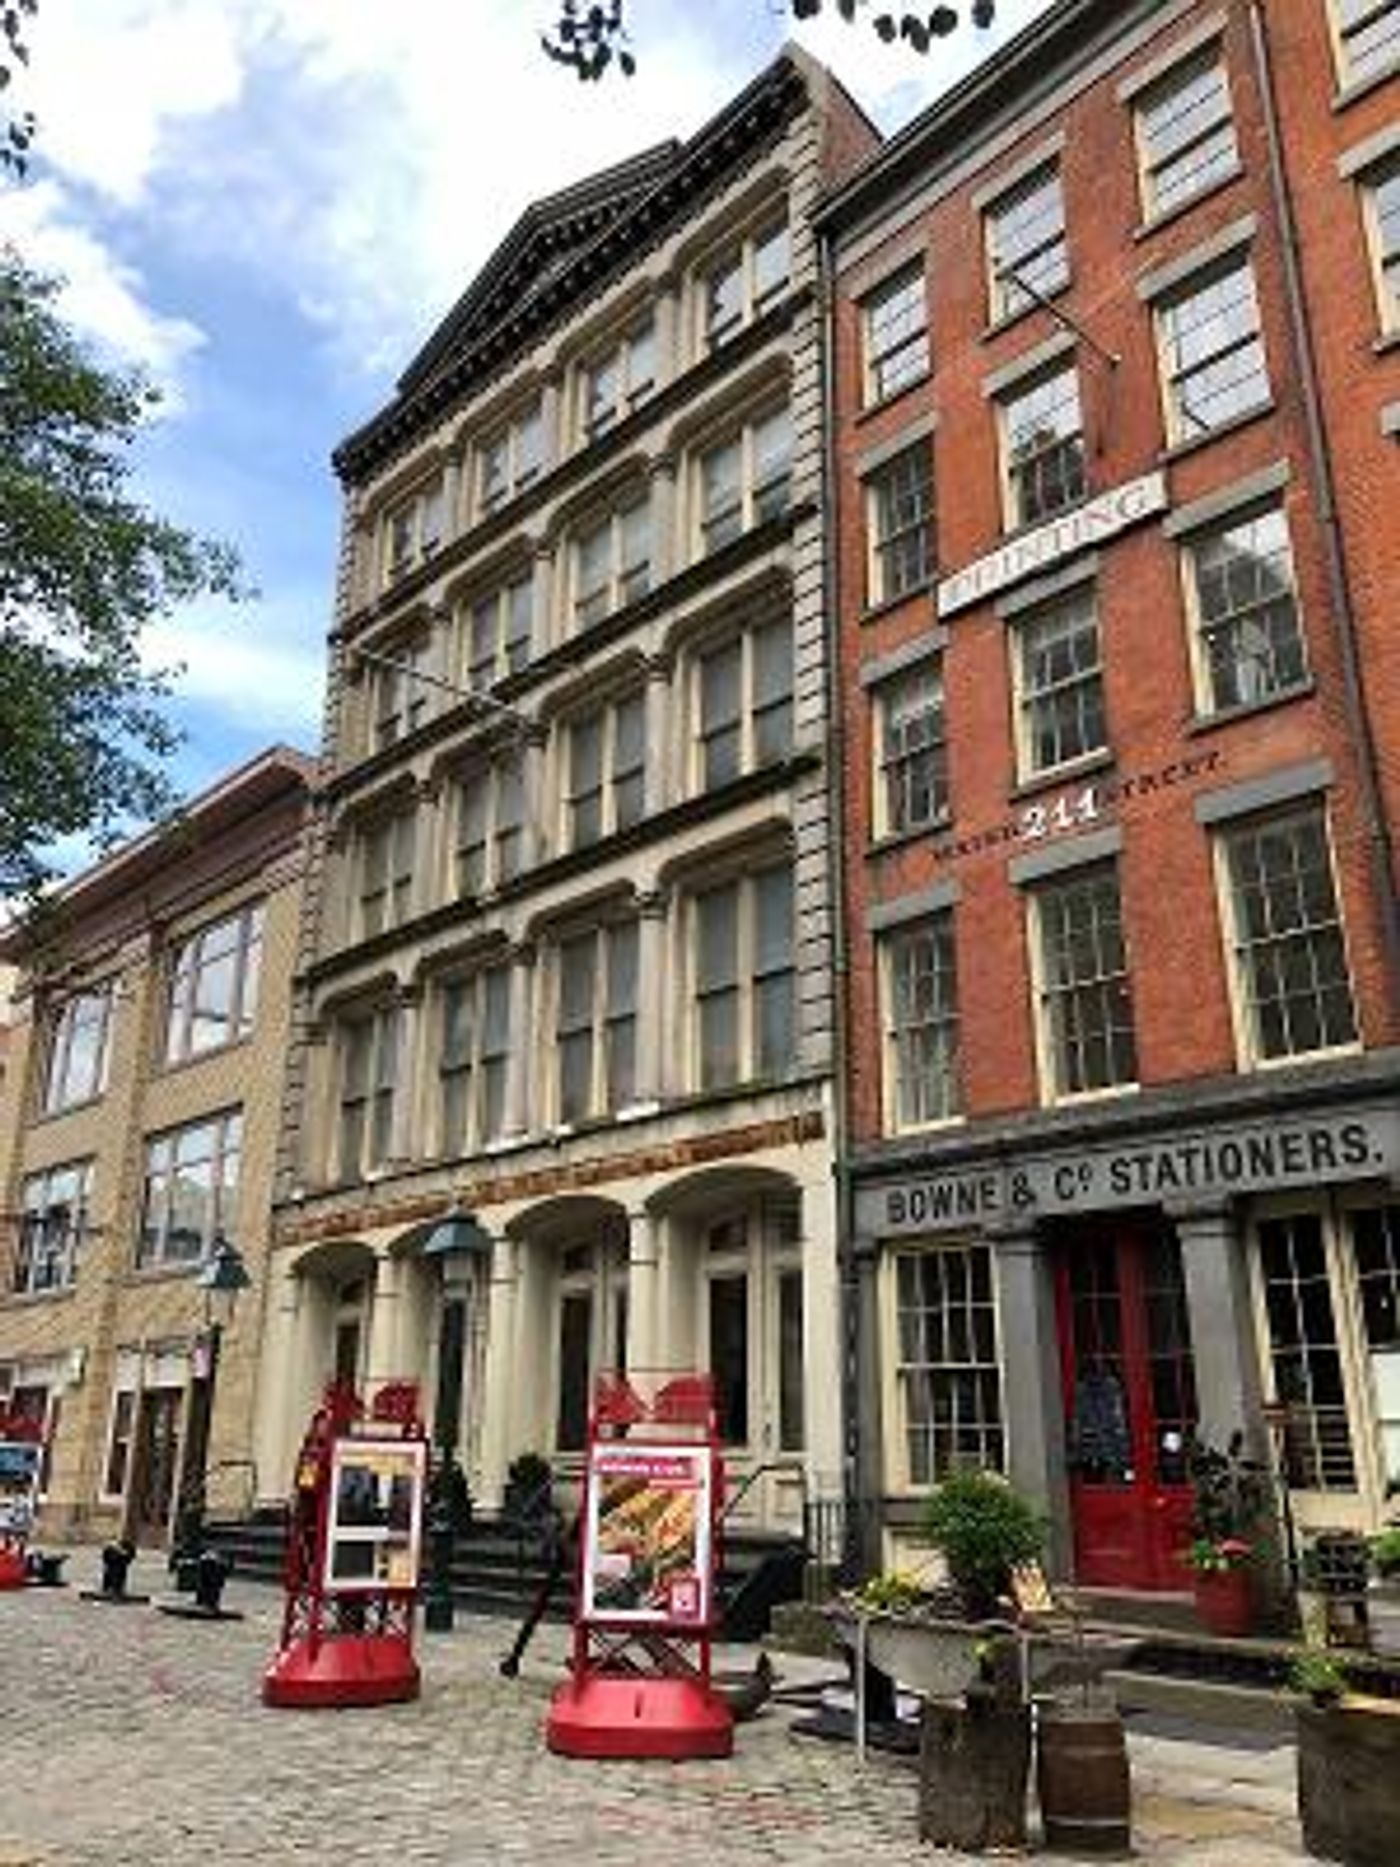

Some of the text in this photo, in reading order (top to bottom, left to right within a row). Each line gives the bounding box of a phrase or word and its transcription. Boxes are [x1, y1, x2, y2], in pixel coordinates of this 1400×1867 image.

[1021, 786, 1099, 841] 211
[885, 1175, 998, 1225] BOWNE
[1011, 1171, 1036, 1206] &
[1109, 1123, 1385, 1194] STATIONERS.
